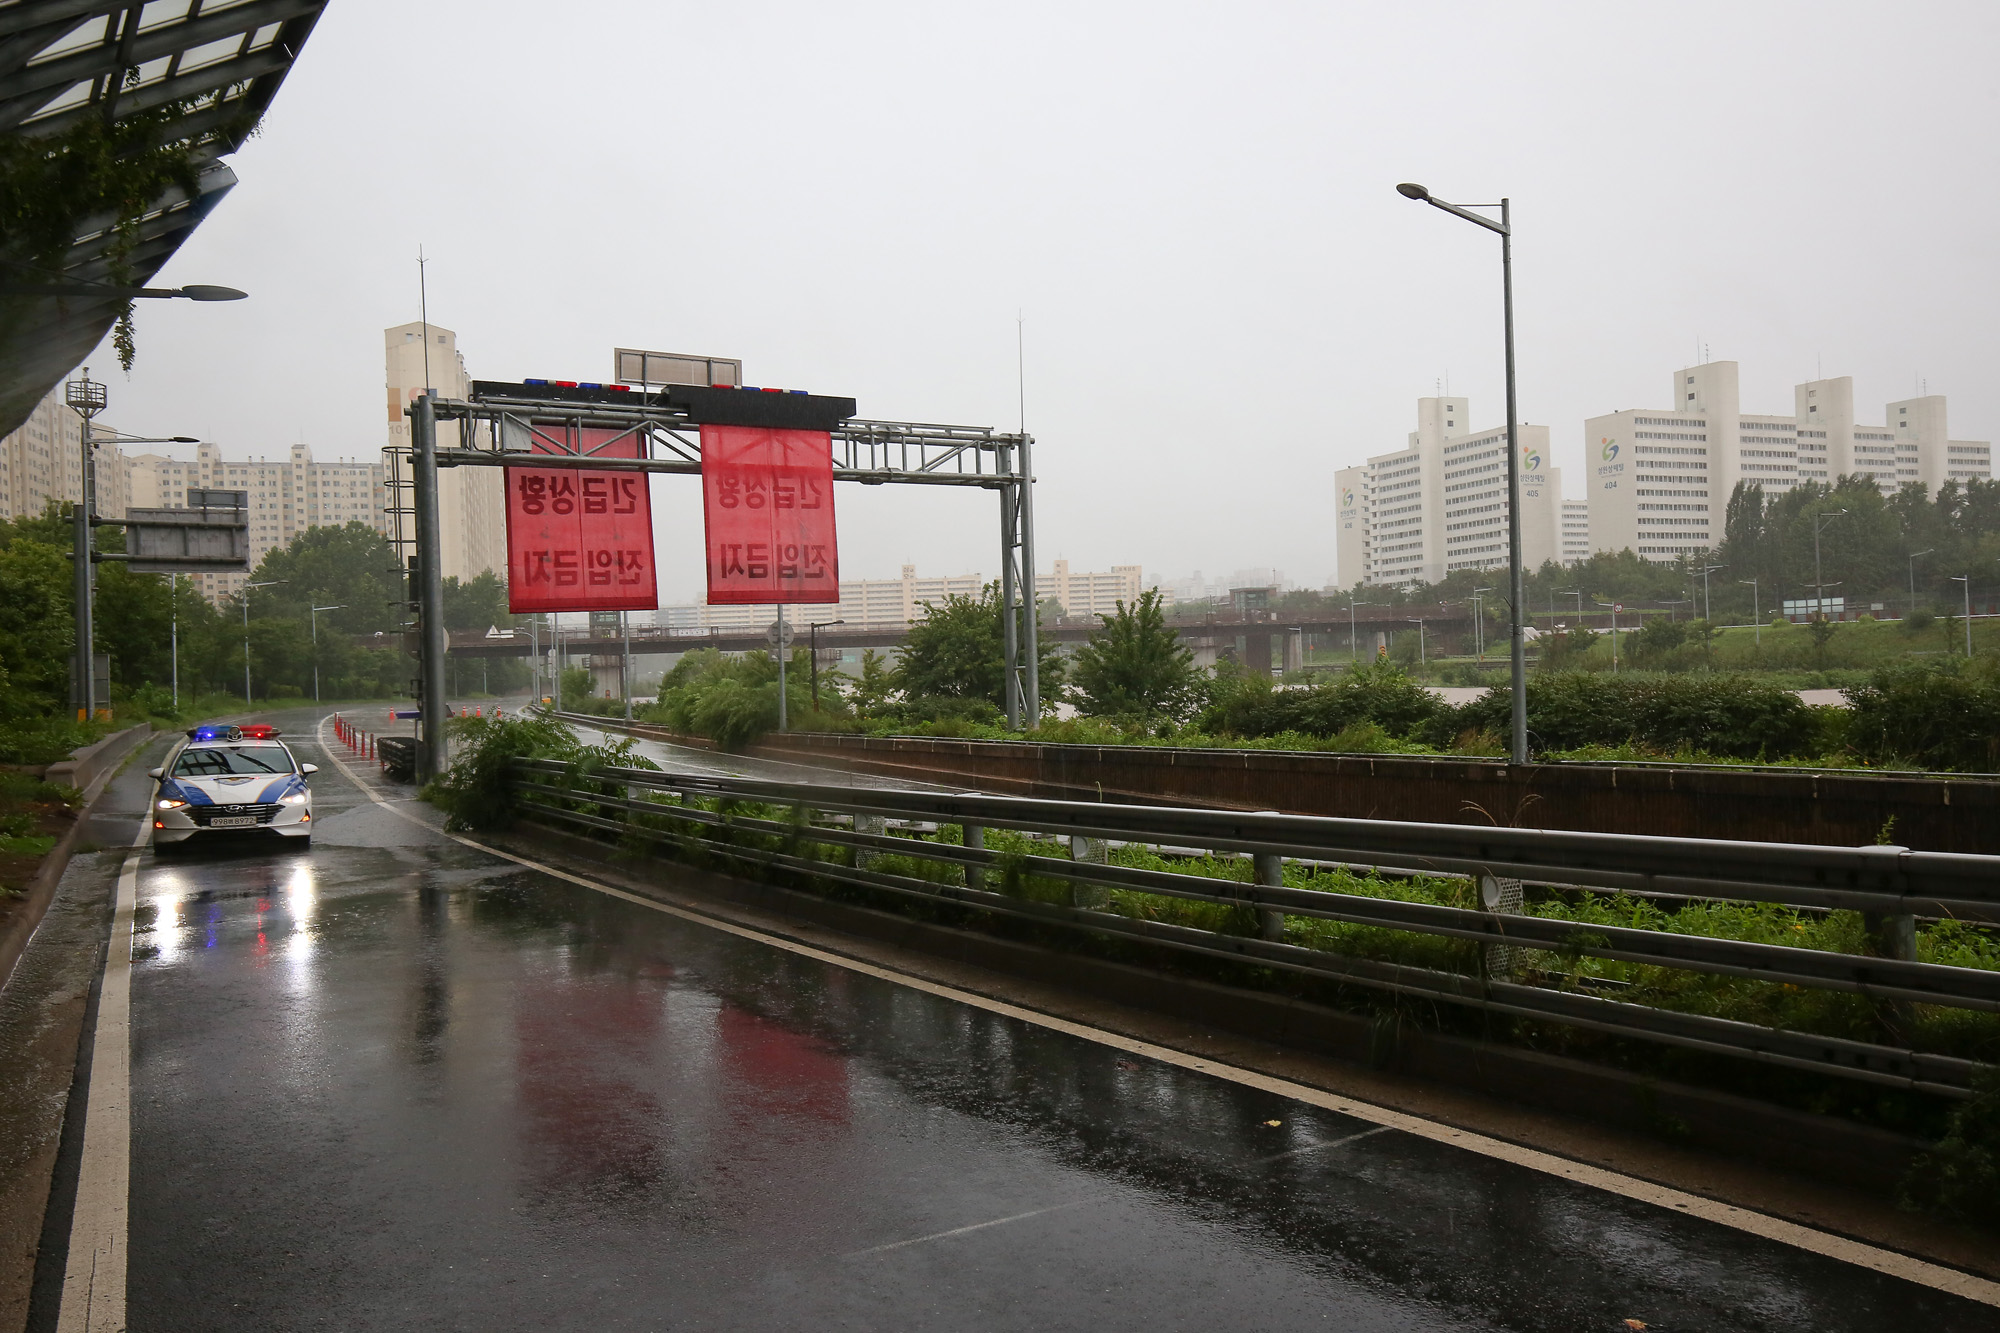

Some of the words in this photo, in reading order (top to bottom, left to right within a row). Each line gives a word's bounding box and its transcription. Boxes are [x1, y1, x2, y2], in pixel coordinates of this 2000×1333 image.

[388, 423, 410, 436] 101
[1604, 480, 1617, 490] 404
[1526, 489, 1539, 498] 405
